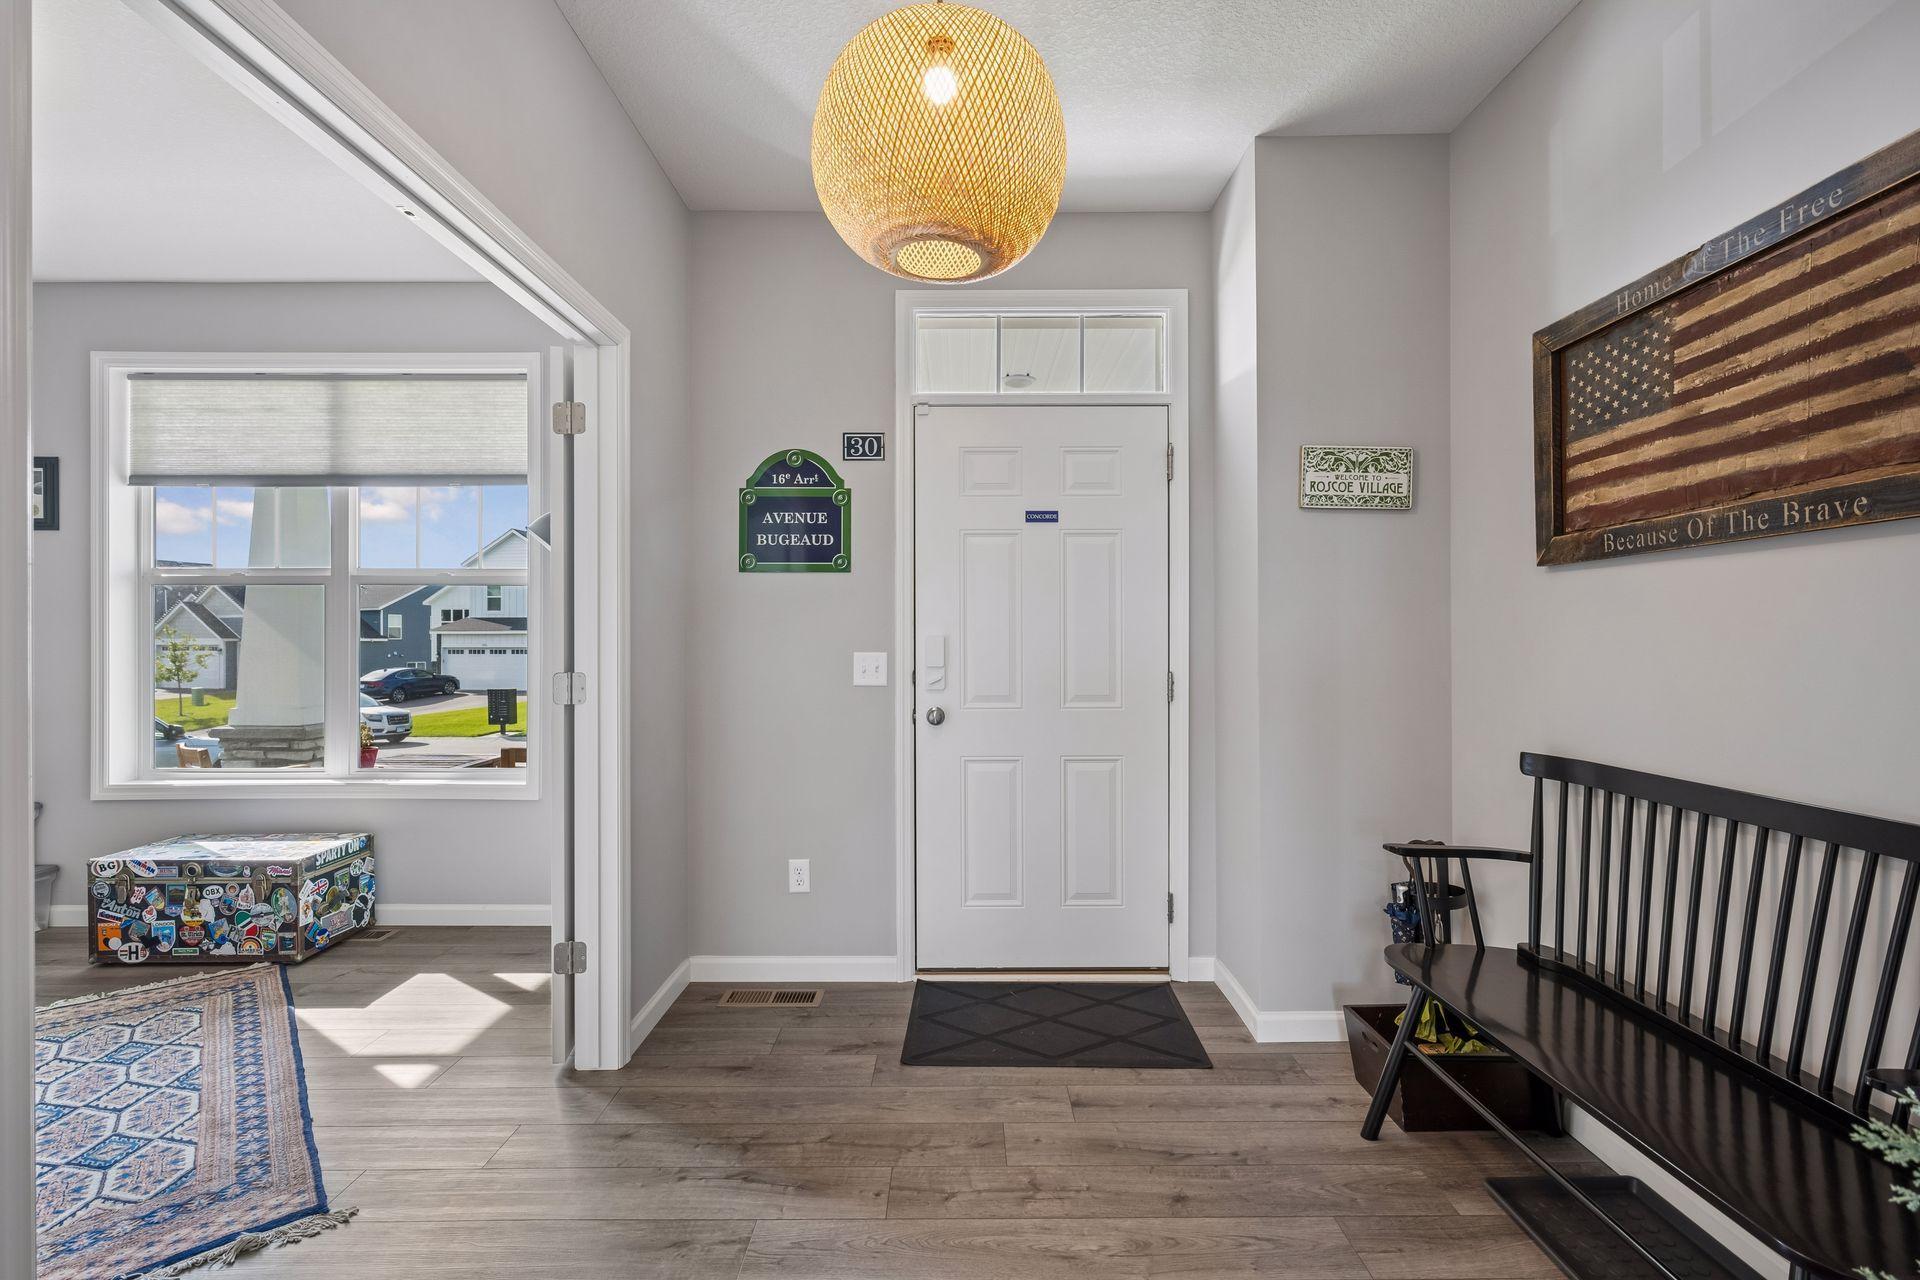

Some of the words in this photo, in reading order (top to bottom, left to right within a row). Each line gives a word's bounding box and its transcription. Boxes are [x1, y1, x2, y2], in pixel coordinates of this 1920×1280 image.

[1615, 272, 1674, 316] Home
[1682, 244, 1714, 282] Of
[1718, 224, 1765, 259] The
[1779, 186, 1845, 235] Free
[850, 437, 878, 456] 30
[1310, 481, 1354, 493] ROSCOE
[1359, 482, 1404, 494] VILLAGE
[762, 512, 828, 524] AVENUE
[1604, 528, 1679, 554] Because
[1687, 514, 1714, 541] Of
[1724, 508, 1770, 535] The
[1782, 495, 1869, 528] Brave
[756, 534, 834, 546] BUGEAUD
[316, 844, 347, 866] SPARTY
[348, 838, 360, 854] ON
[99, 861, 116, 872] BG
[205, 888, 220, 896] OBX
